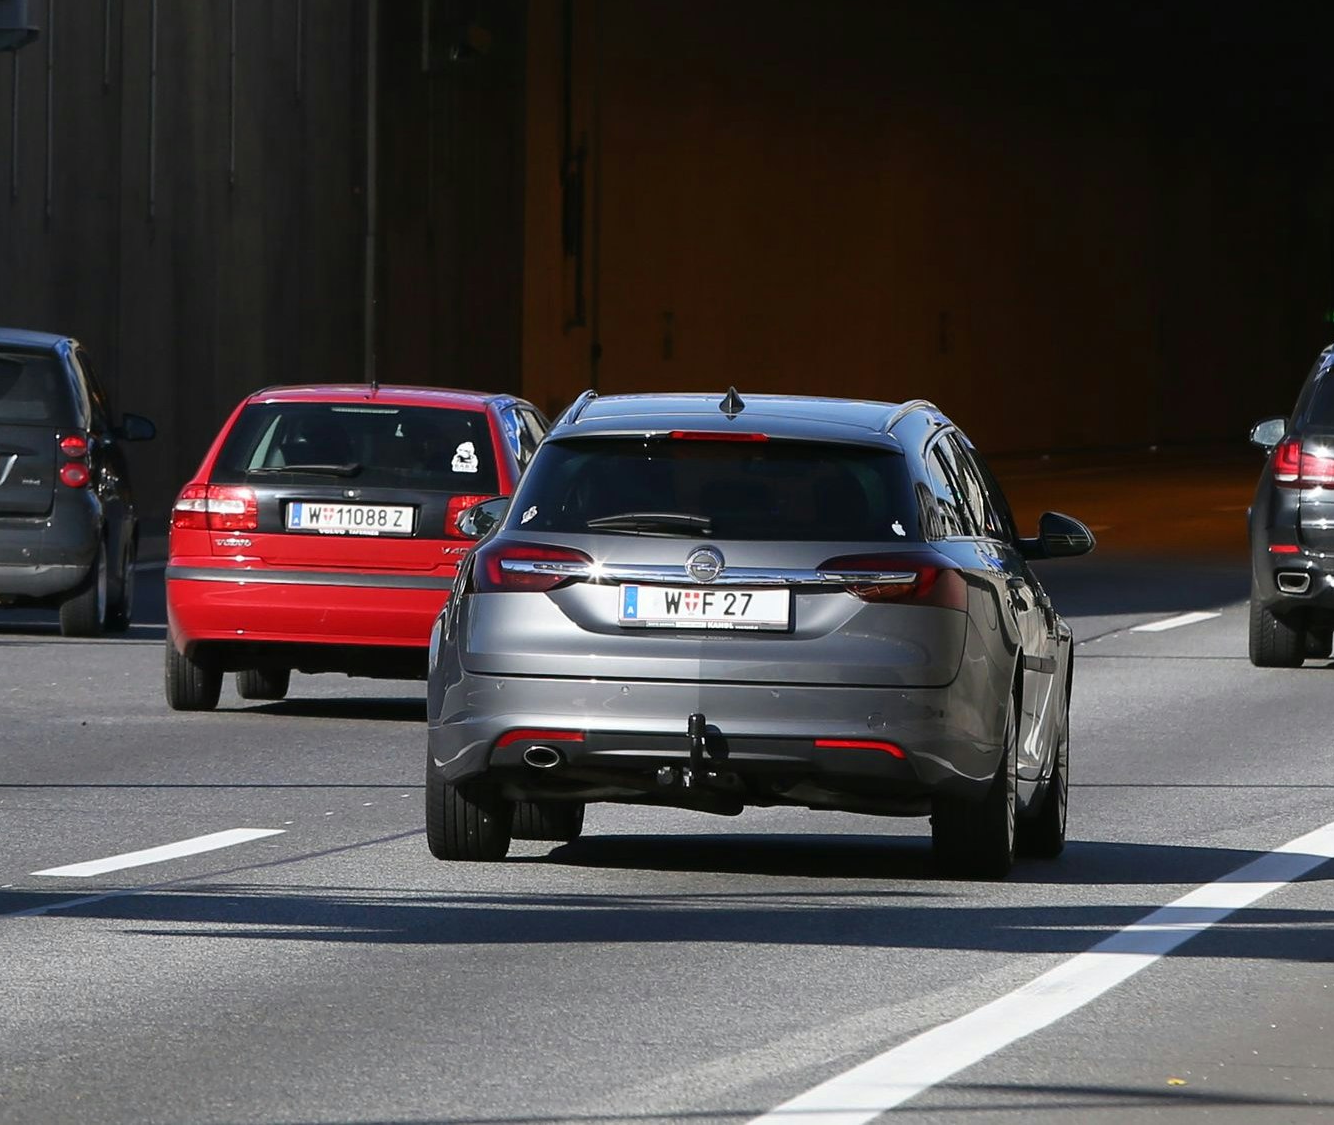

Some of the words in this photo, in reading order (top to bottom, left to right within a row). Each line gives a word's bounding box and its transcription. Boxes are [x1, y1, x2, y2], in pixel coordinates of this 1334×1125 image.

[309, 506, 322, 524] W
[336, 508, 387, 526] 11088
[215, 538, 252, 546] VOLVO
[627, 606, 634, 614] A
[665, 591, 682, 615] W
[702, 592, 715, 615] F
[723, 593, 753, 616] 27
